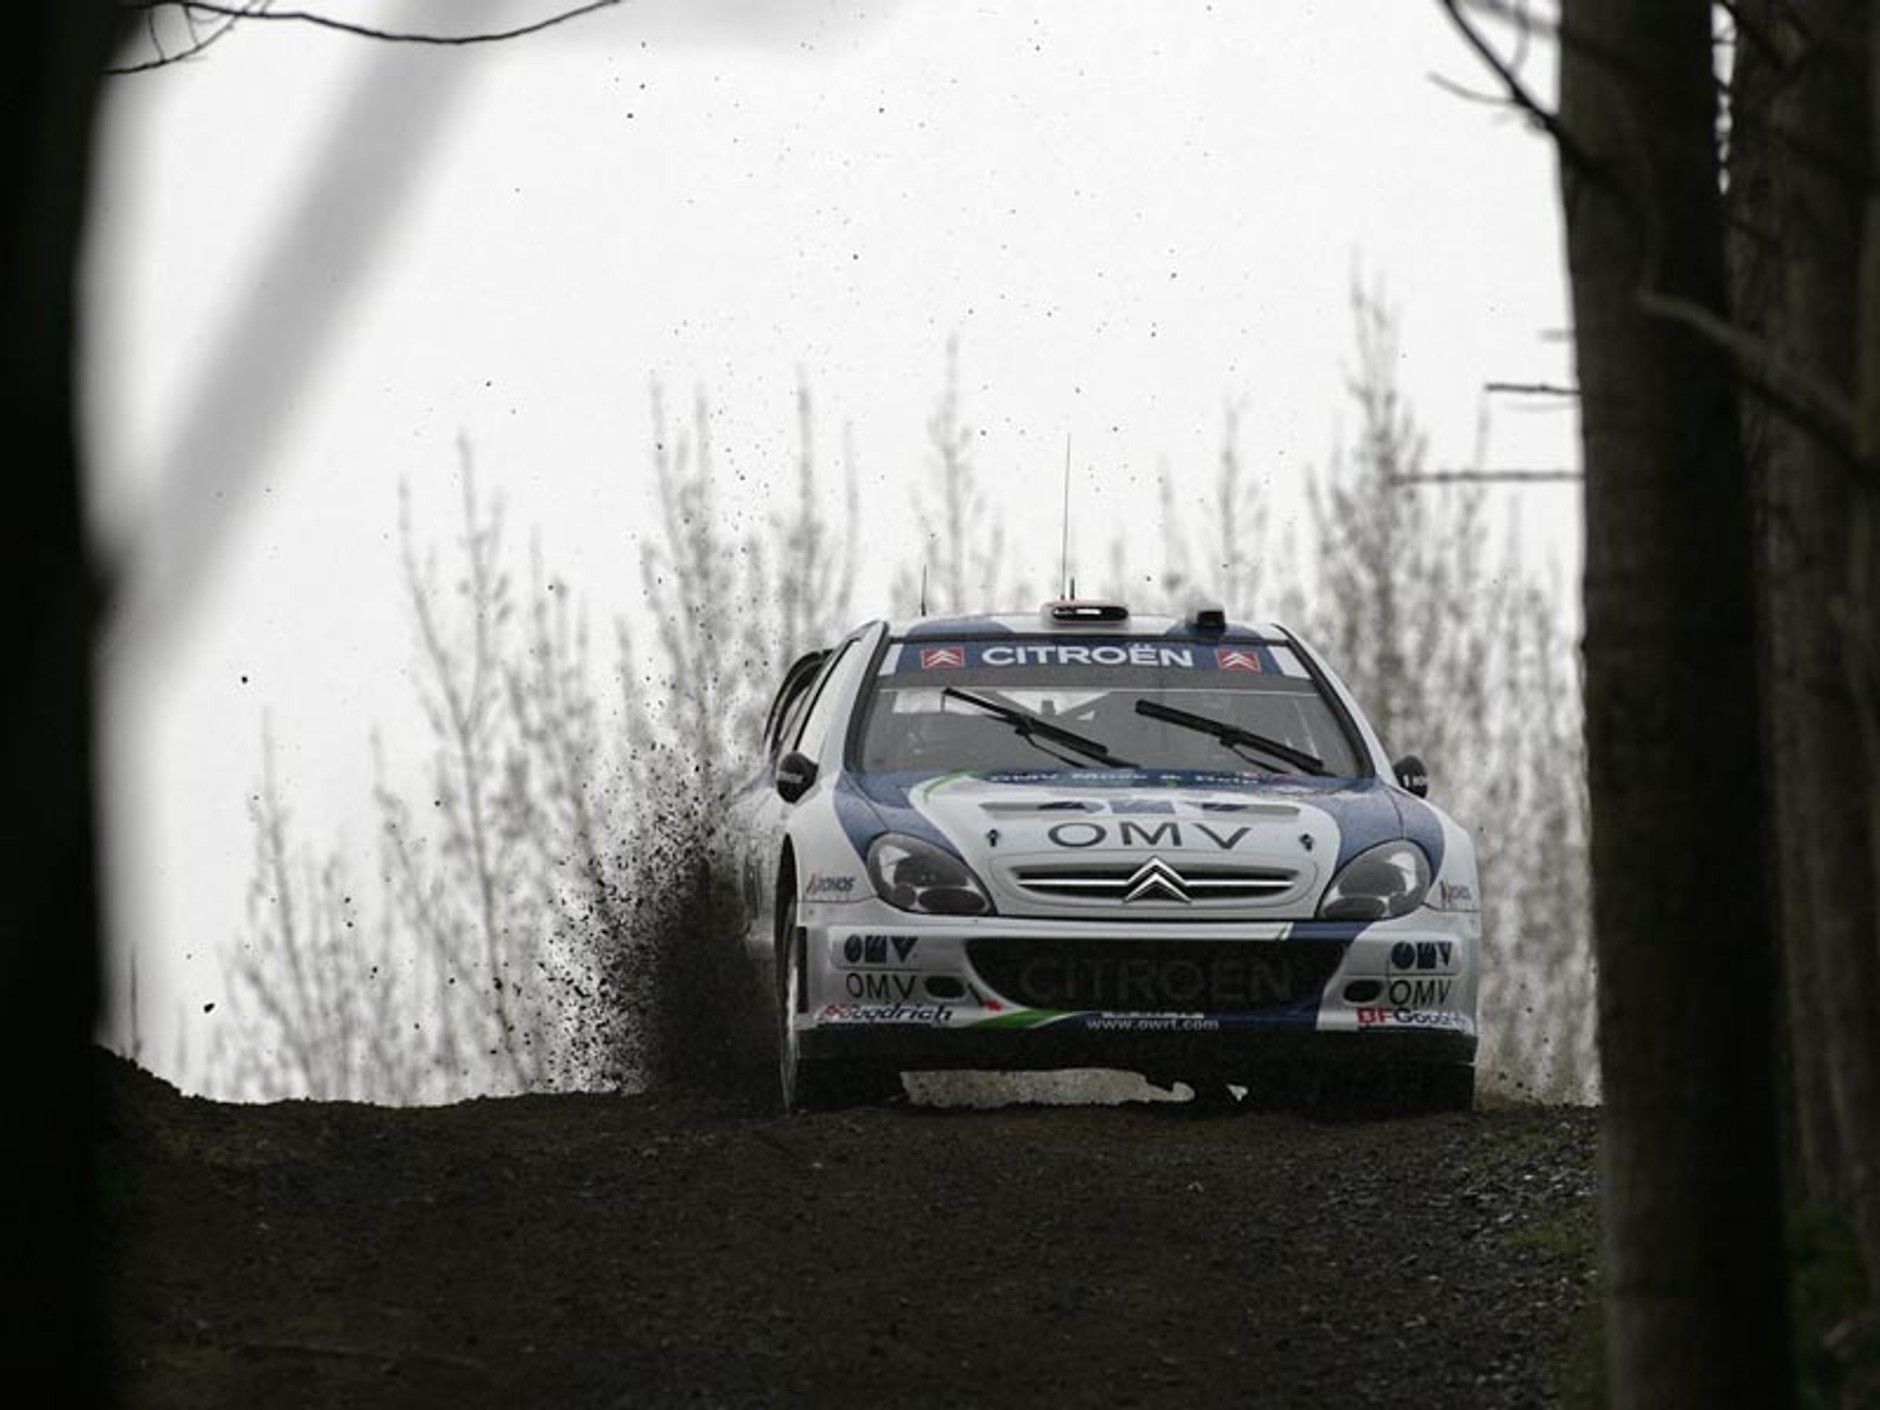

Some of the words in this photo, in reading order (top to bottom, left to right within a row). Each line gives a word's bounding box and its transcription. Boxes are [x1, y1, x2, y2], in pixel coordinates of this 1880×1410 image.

[981, 643, 1194, 667] CITROËN
[1048, 822, 1252, 850] OMV
[845, 972, 918, 1000] OMV
[1389, 980, 1452, 1006] OMV
[1085, 1018, 1219, 1031] www.owrt.com
